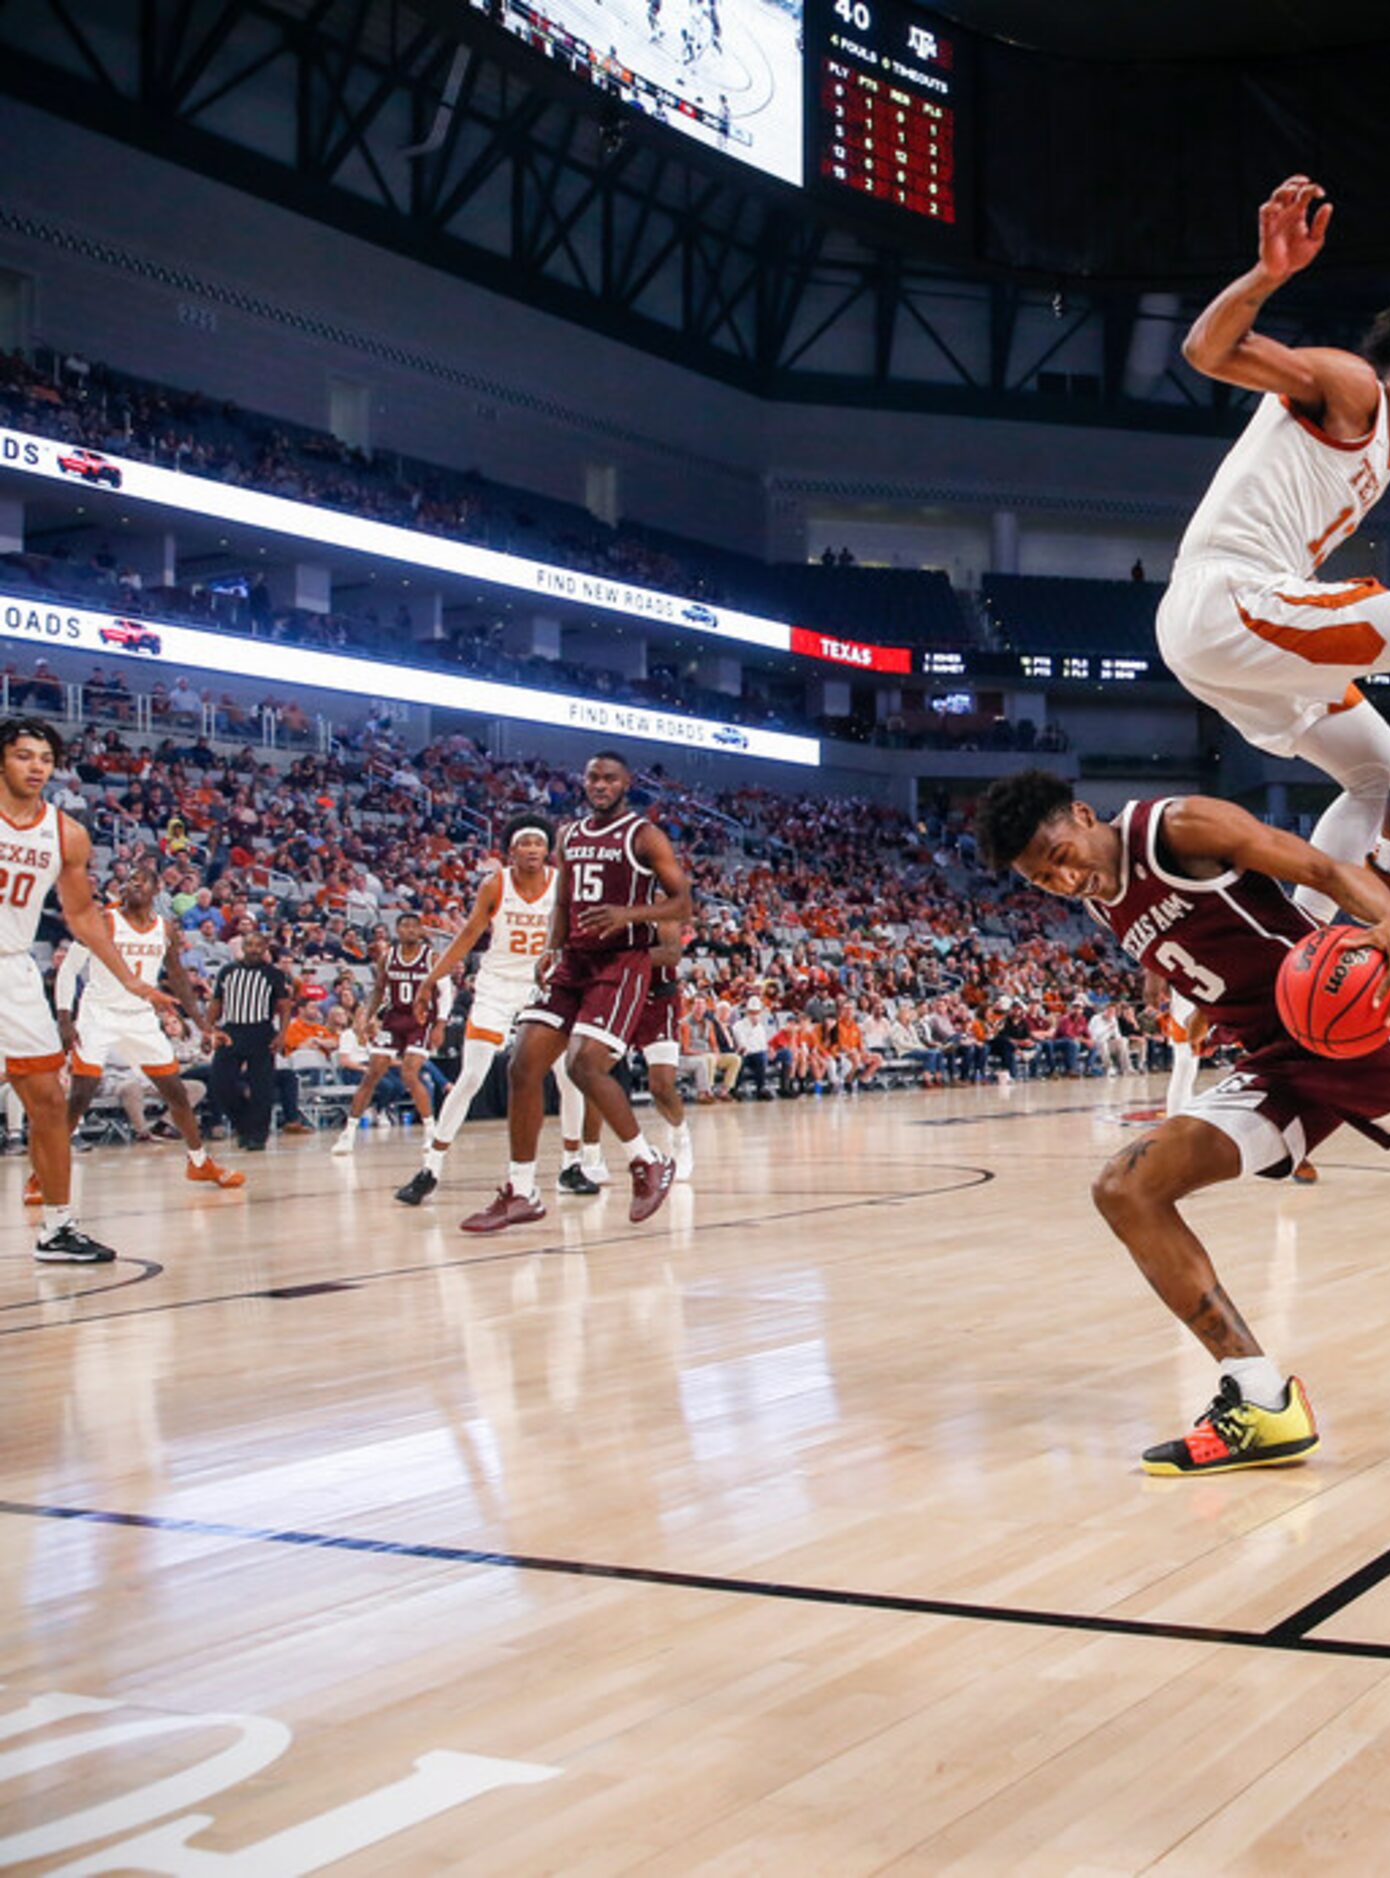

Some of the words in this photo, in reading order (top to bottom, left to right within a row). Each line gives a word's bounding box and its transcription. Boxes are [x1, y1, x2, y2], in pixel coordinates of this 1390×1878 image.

[835, 0, 870, 30] 40
[841, 37, 877, 63] FOULS
[892, 60, 948, 93] TIMEOUTS
[537, 569, 577, 594] FIND
[583, 582, 620, 604] NEW
[624, 591, 674, 617] ROADS
[820, 637, 873, 666] TEXAS
[569, 704, 608, 726] FIND
[615, 712, 650, 732] NEW
[656, 719, 704, 742] ROADS
[565, 846, 595, 861] TEXAS
[573, 863, 604, 902] 15
[505, 911, 546, 928] TEXA
[510, 929, 547, 956] 22
[1155, 941, 1227, 1003] 3
[399, 981, 413, 1004] 0
